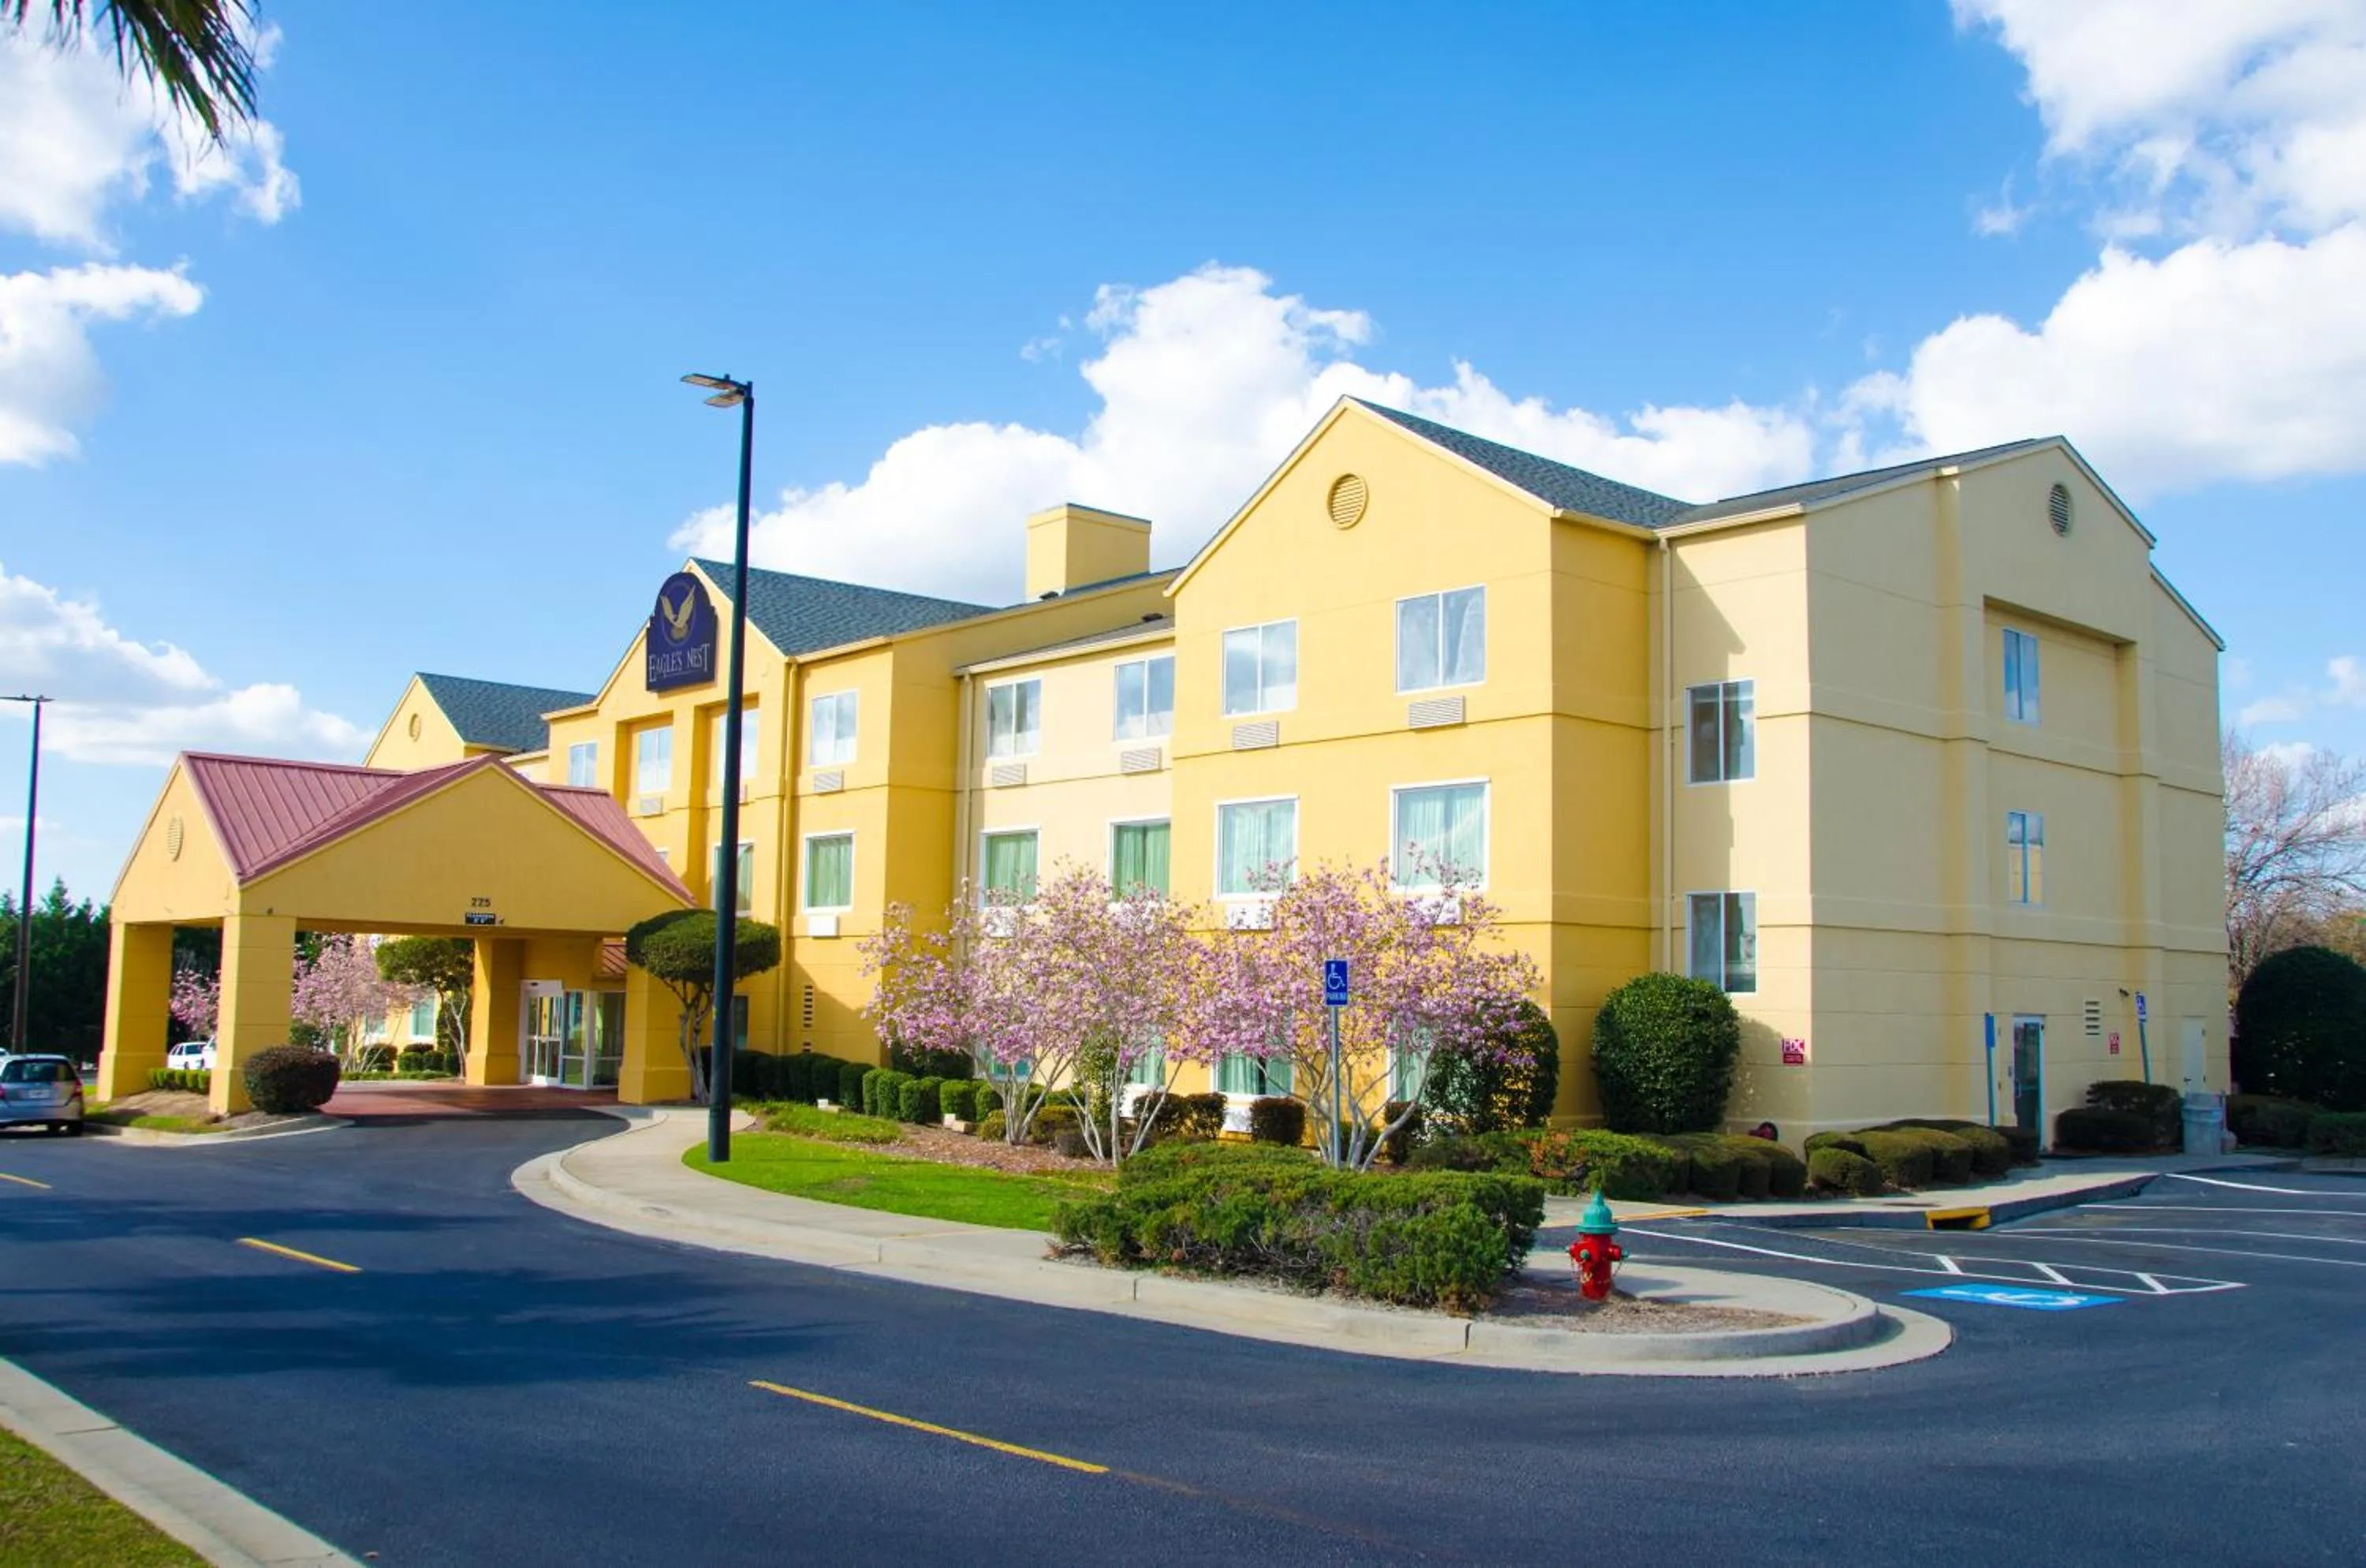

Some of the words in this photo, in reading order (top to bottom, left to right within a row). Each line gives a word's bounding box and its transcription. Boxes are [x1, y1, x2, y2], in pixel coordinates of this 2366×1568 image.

[648, 651, 682, 682] EAGLES
[687, 644, 710, 673] NEST
[472, 897, 491, 907] 225
